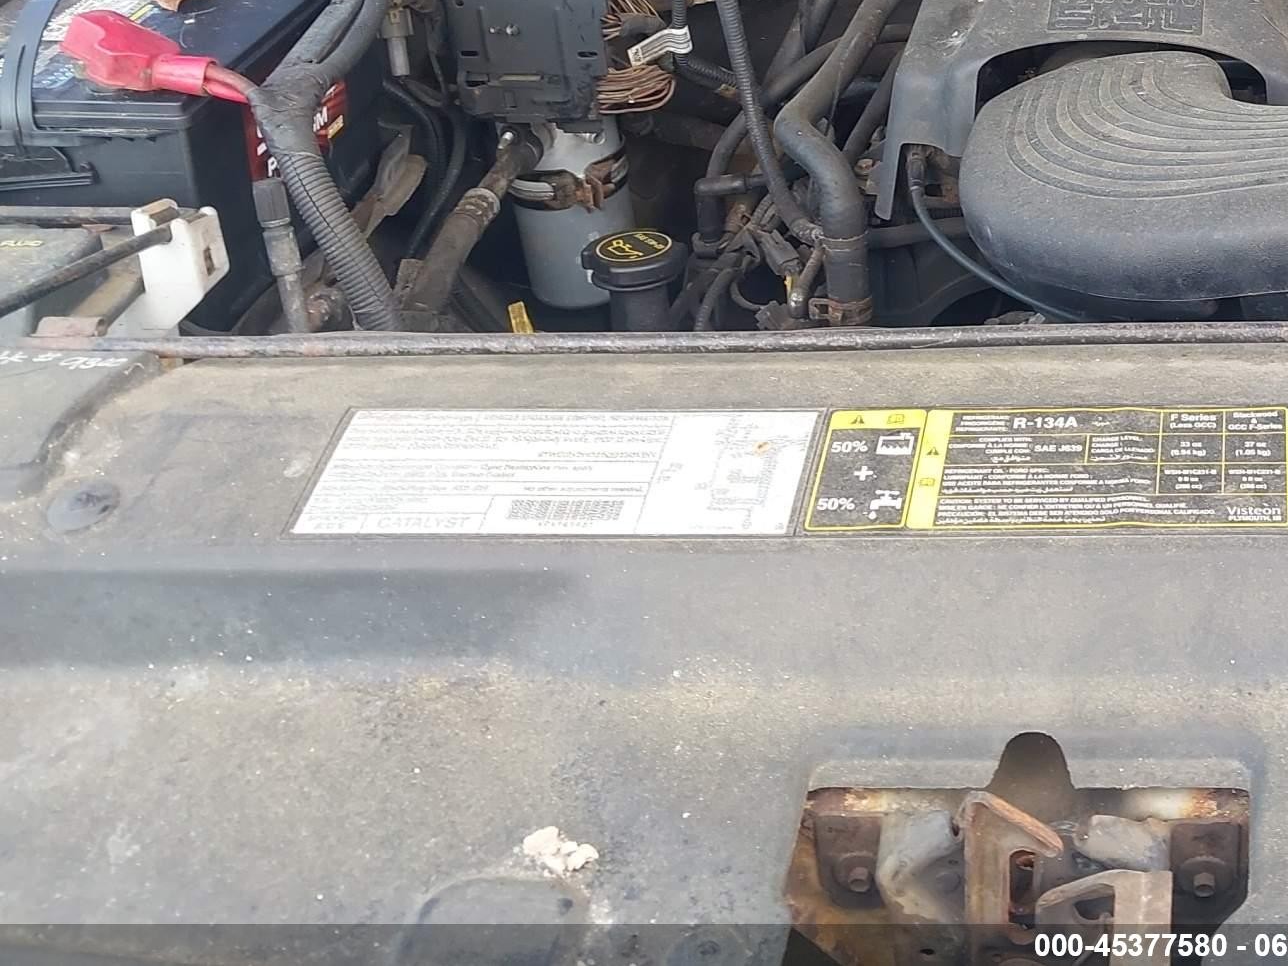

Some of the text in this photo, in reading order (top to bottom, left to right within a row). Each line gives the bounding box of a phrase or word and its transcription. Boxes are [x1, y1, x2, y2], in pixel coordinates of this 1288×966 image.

[1013, 416, 1078, 429] R-134A
[1181, 413, 1217, 422] Series
[831, 440, 868, 453] 50%
[817, 497, 855, 510] 50%
[1226, 506, 1282, 516] Visteon
[377, 517, 472, 529] CATALYST
